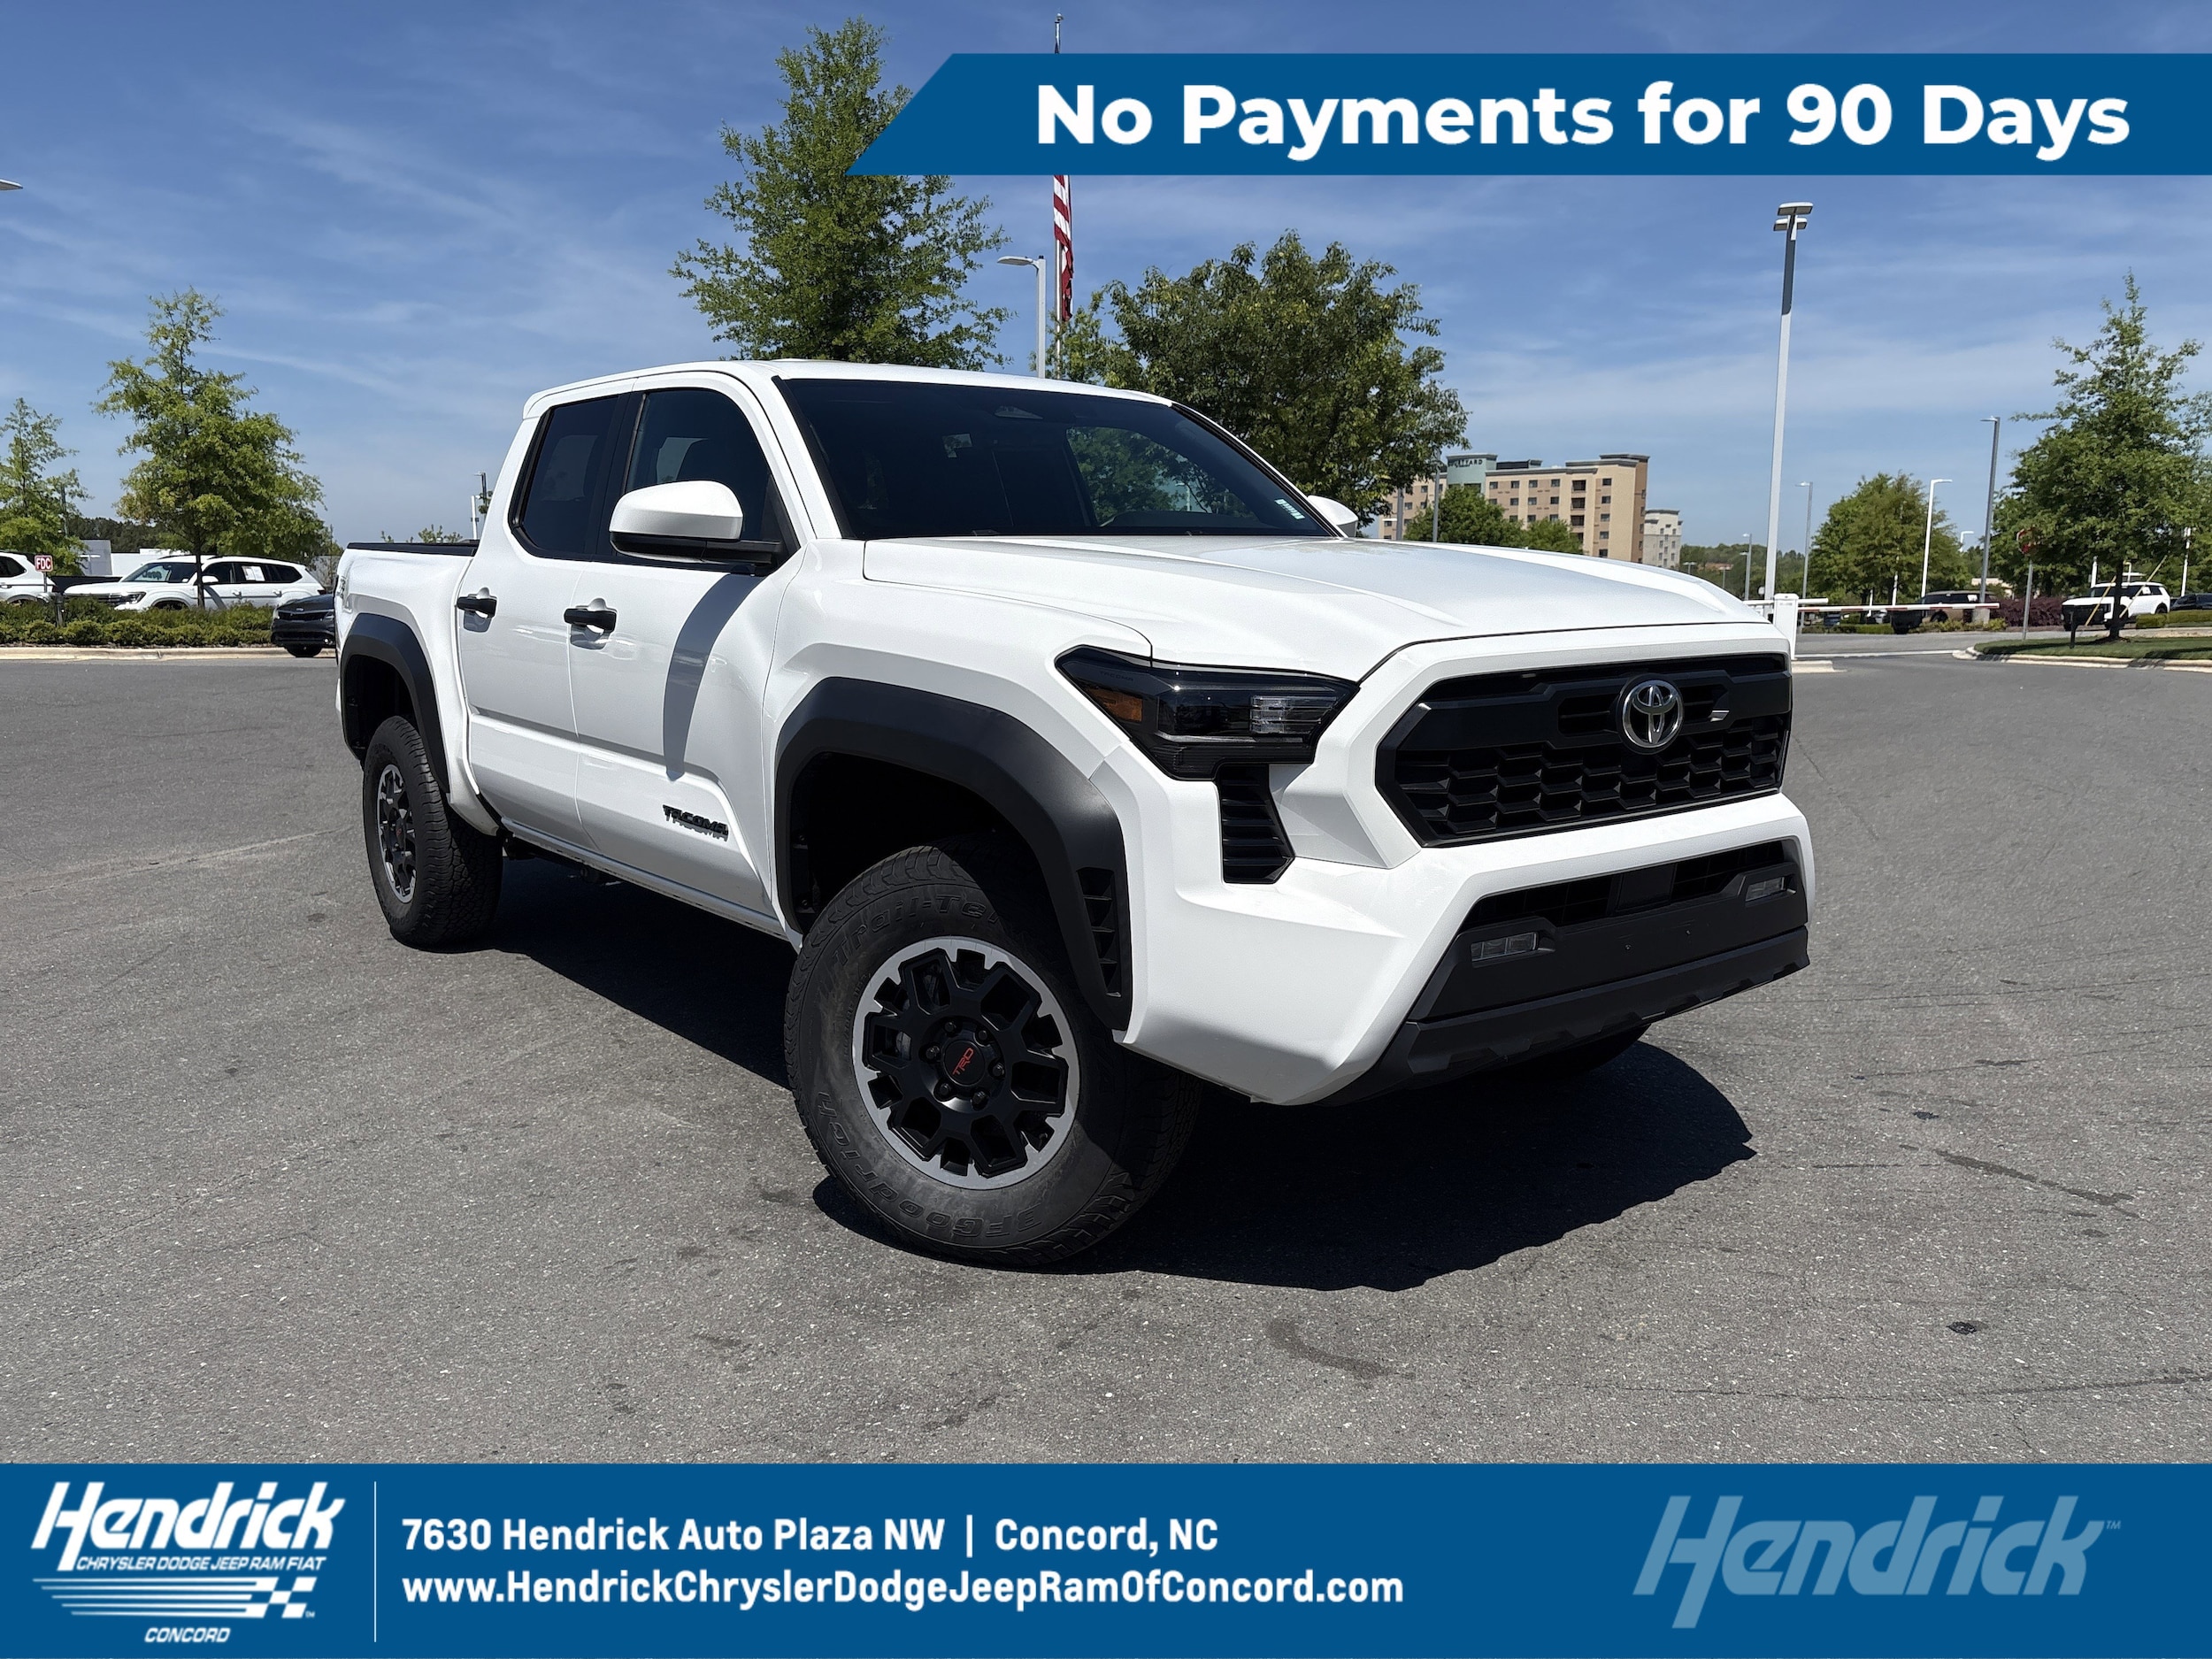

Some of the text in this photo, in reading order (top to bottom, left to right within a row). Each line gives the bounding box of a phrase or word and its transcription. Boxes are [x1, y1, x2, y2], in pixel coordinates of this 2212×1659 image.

[36, 557, 51, 570] FDC
[663, 804, 729, 836] TACOMA
[952, 1048, 974, 1074] TRD
